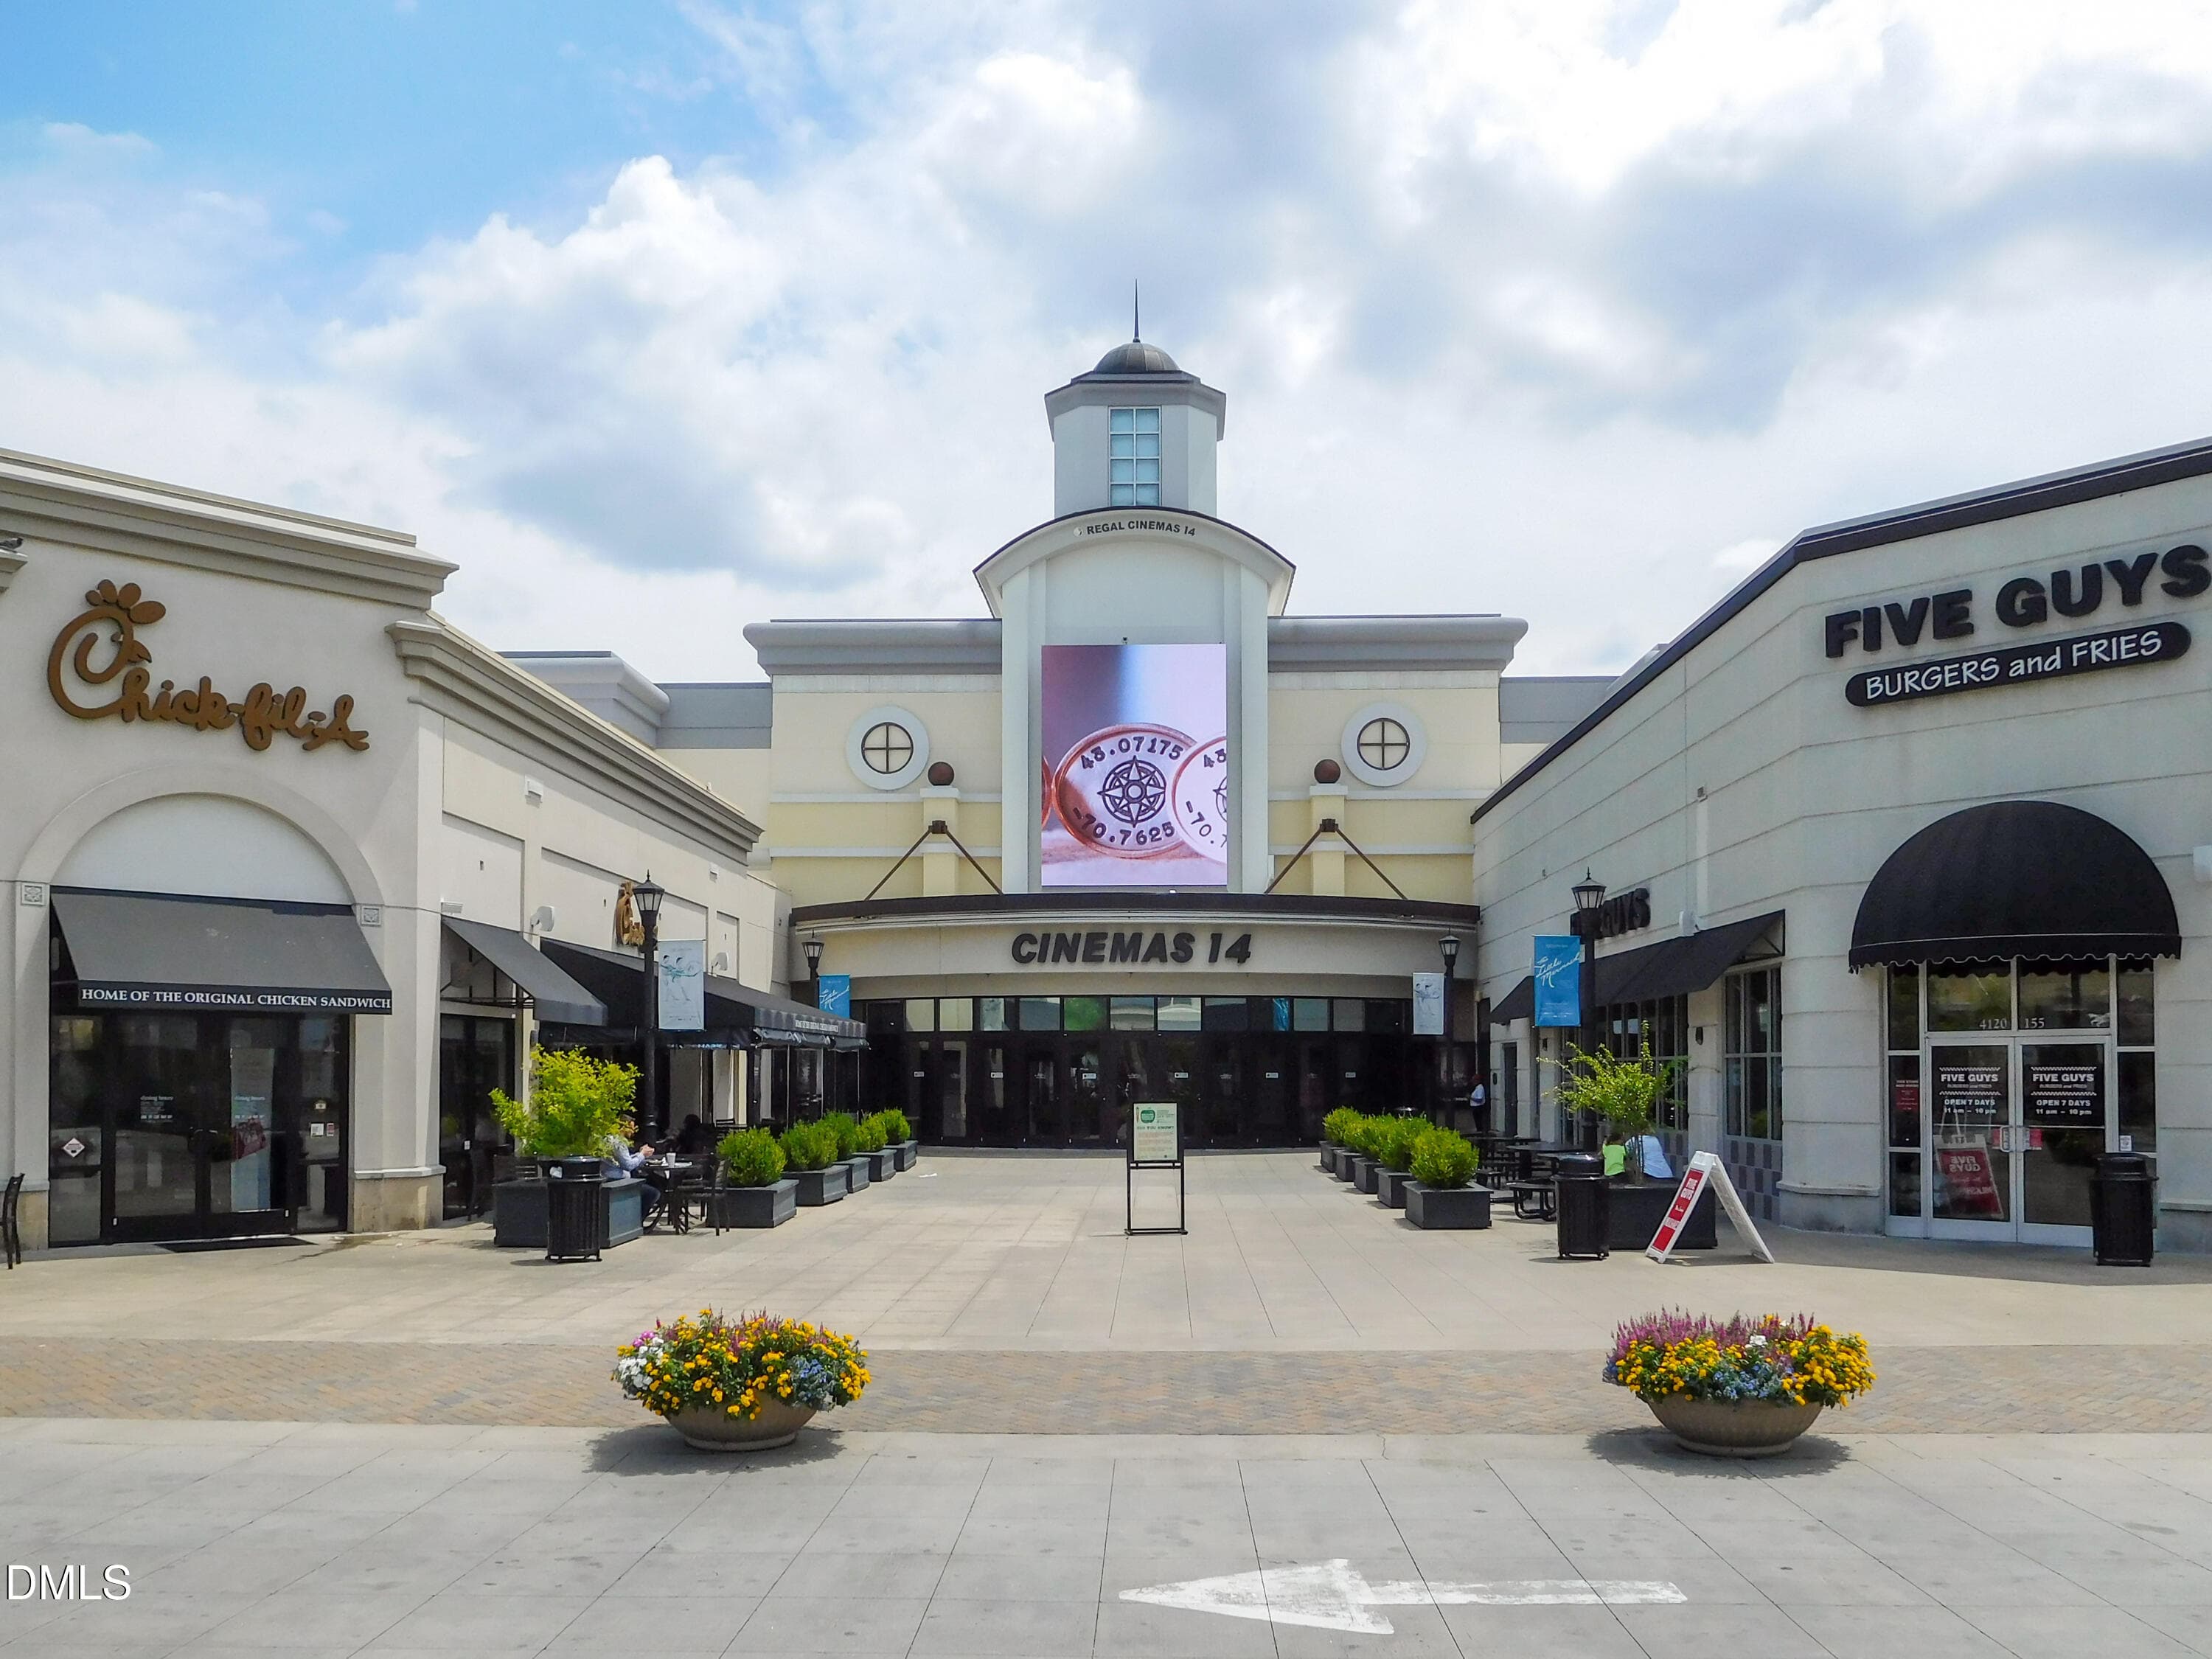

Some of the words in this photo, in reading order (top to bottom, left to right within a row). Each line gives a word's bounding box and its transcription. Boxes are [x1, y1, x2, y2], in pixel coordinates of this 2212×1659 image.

[1087, 521, 1125, 535] REGAL
[1127, 521, 1180, 533] CINEMAS
[1183, 526, 1195, 536] 14
[1825, 589, 1975, 658] FIVE
[1995, 544, 2212, 627] GUYS
[48, 579, 369, 751] Chick-fil-A
[1865, 657, 2000, 700] BURGERS
[2009, 646, 2062, 678] and
[2071, 630, 2162, 667] FRIES
[1011, 932, 1196, 964] CINEMAS
[1208, 933, 1252, 964] 14
[81, 989, 128, 1001] HOME
[131, 990, 150, 1001] OF
[153, 991, 182, 1003] THE
[184, 992, 255, 1005] ORIGINAL
[257, 995, 317, 1007] CHICKEN
[320, 997, 392, 1009] SANDWICH
[1979, 1018, 2007, 1029] 4120
[2024, 1018, 2045, 1029] 155
[1941, 1074, 1965, 1082] FIVE
[1968, 1074, 1999, 1082] GUYS
[2032, 1074, 2059, 1082] FIVE
[2062, 1074, 2094, 1082] GUYS
